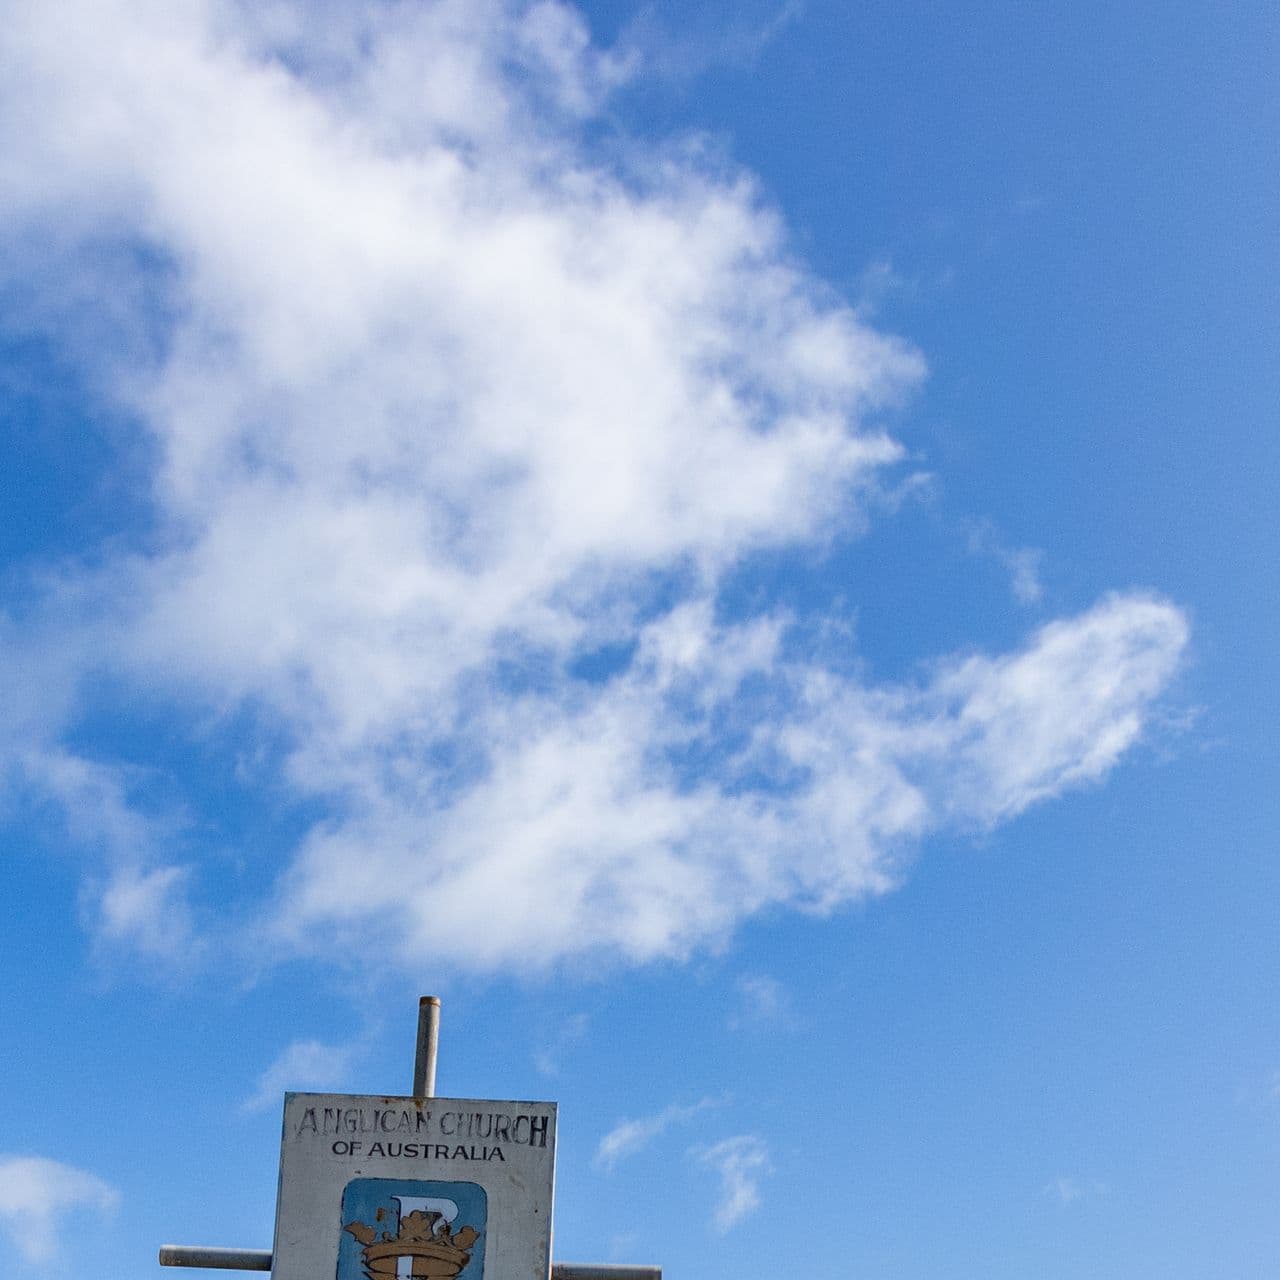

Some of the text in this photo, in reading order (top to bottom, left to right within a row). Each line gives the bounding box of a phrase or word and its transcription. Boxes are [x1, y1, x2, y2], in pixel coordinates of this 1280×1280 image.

[295, 1106, 549, 1147] ANGLICAN CHURCH
[332, 1141, 505, 1161] OF AUSTRALIA
